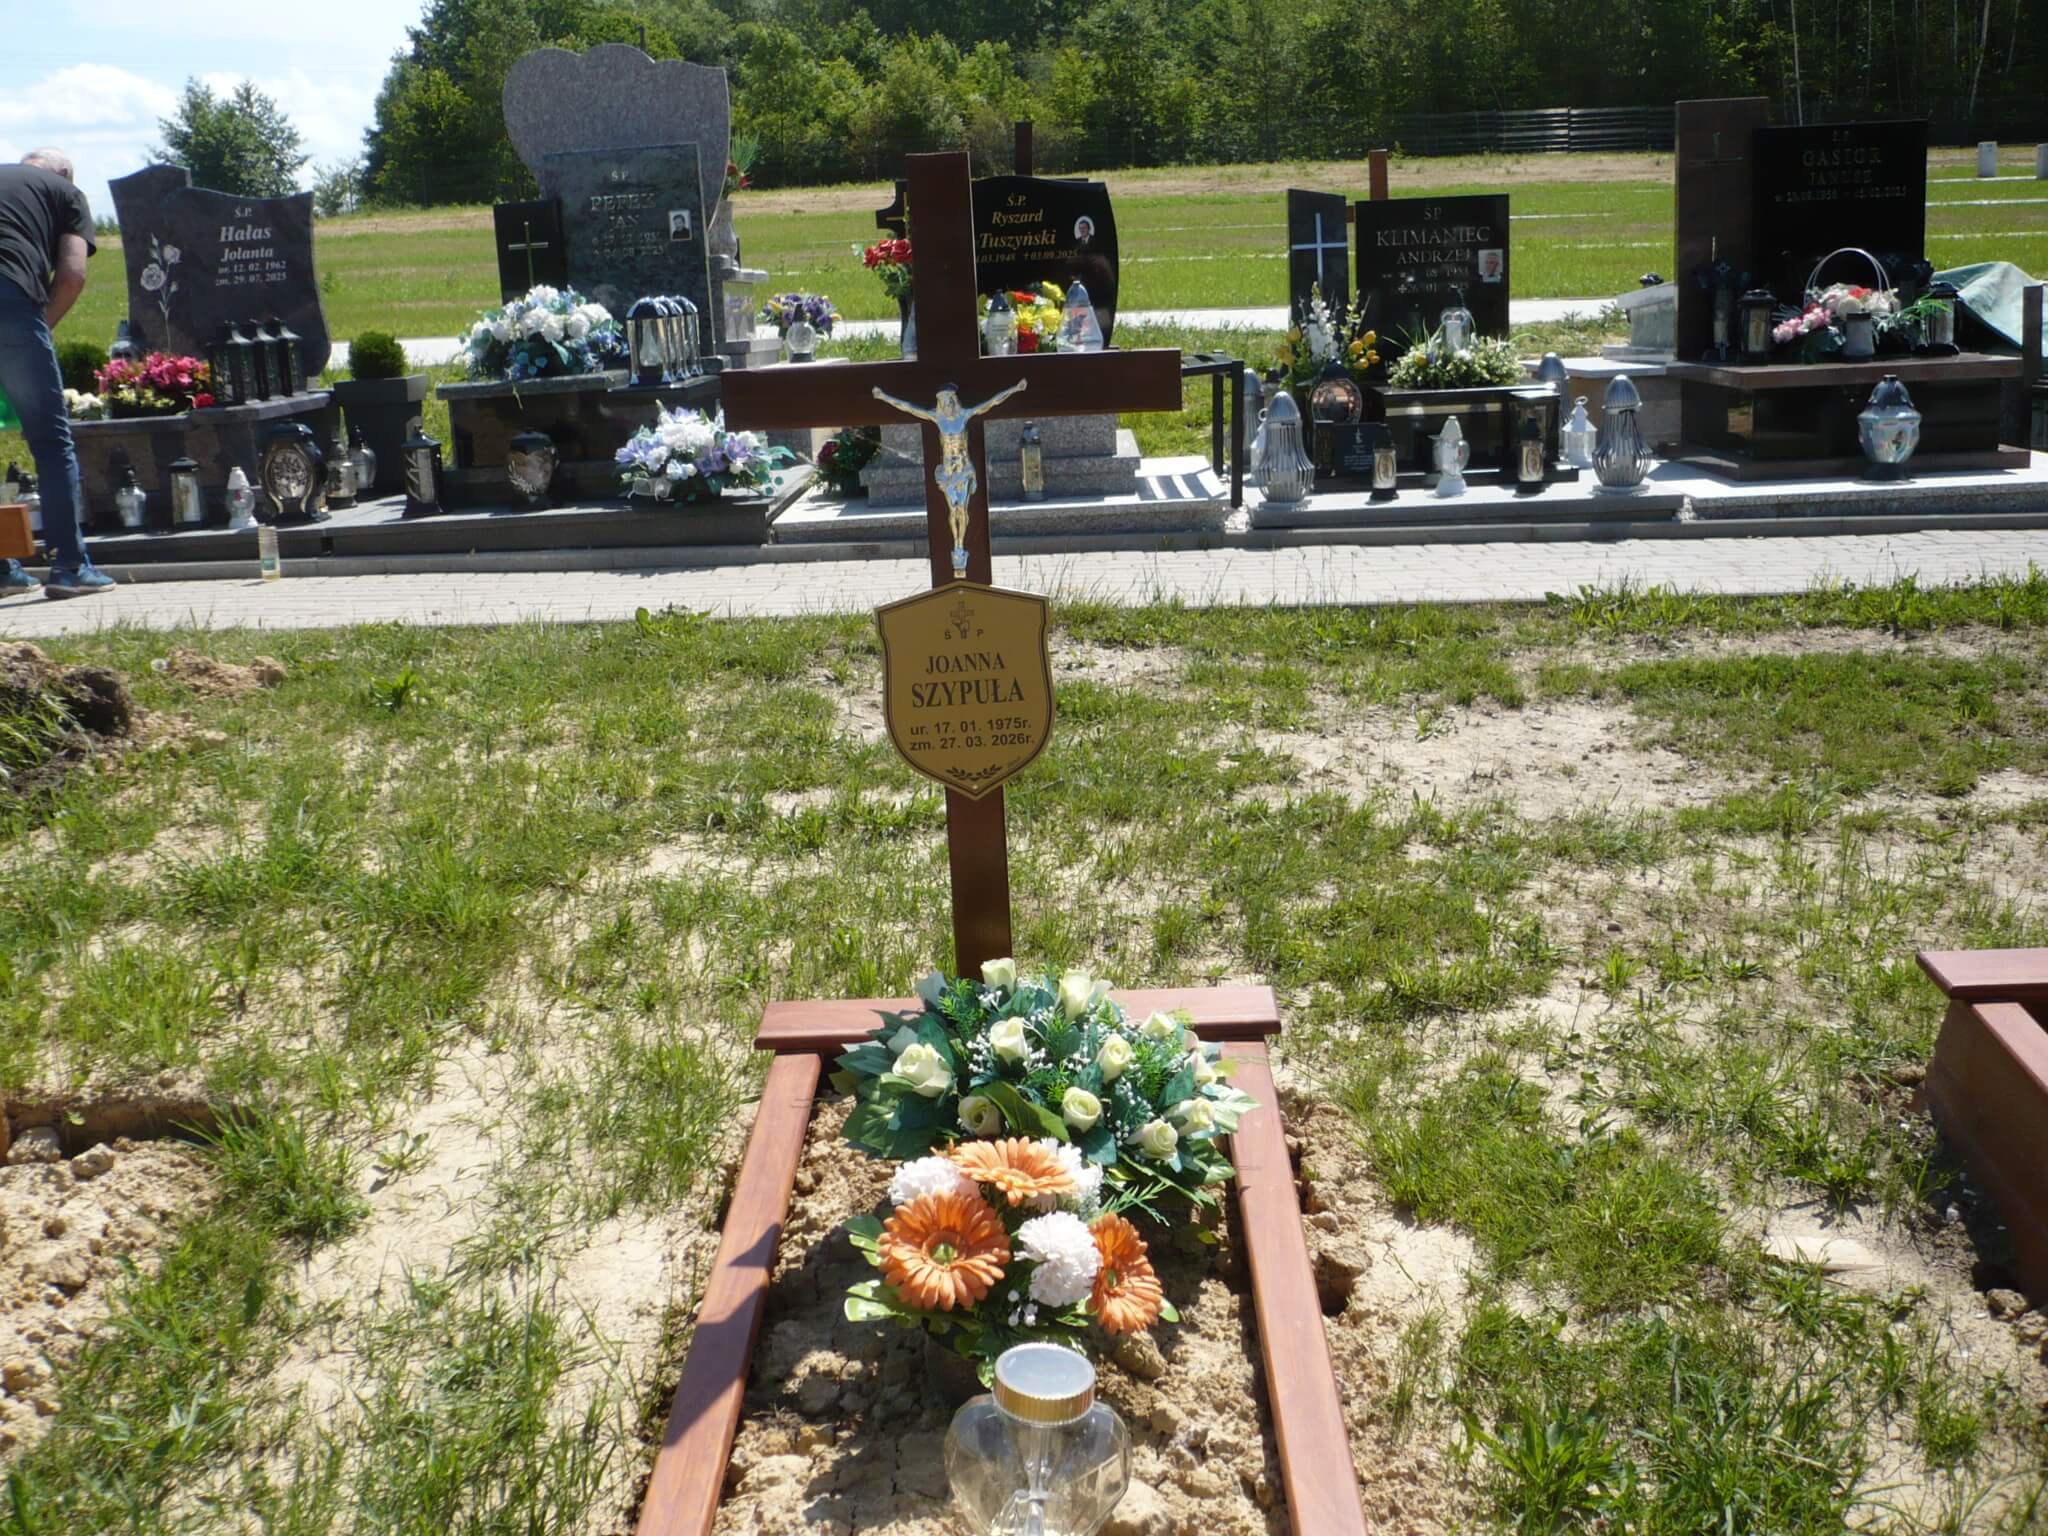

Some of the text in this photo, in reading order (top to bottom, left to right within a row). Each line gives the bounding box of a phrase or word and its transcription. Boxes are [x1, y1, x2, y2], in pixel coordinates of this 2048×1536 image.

[991, 209, 1044, 227] Ryszard
[980, 229, 1057, 250] Tuszyński
[1376, 226, 1490, 247] KLIMANIEC
[220, 246, 274, 263] Jolanta
[1396, 250, 1472, 265] ANDRZEJ
[925, 652, 1006, 674] JOANNA
[912, 677, 1025, 708] SZYPUŁA
[910, 717, 1032, 736] ur. 17. 01. 1975r.
[910, 733, 1035, 751] zm. 27. 03. 2026r.
